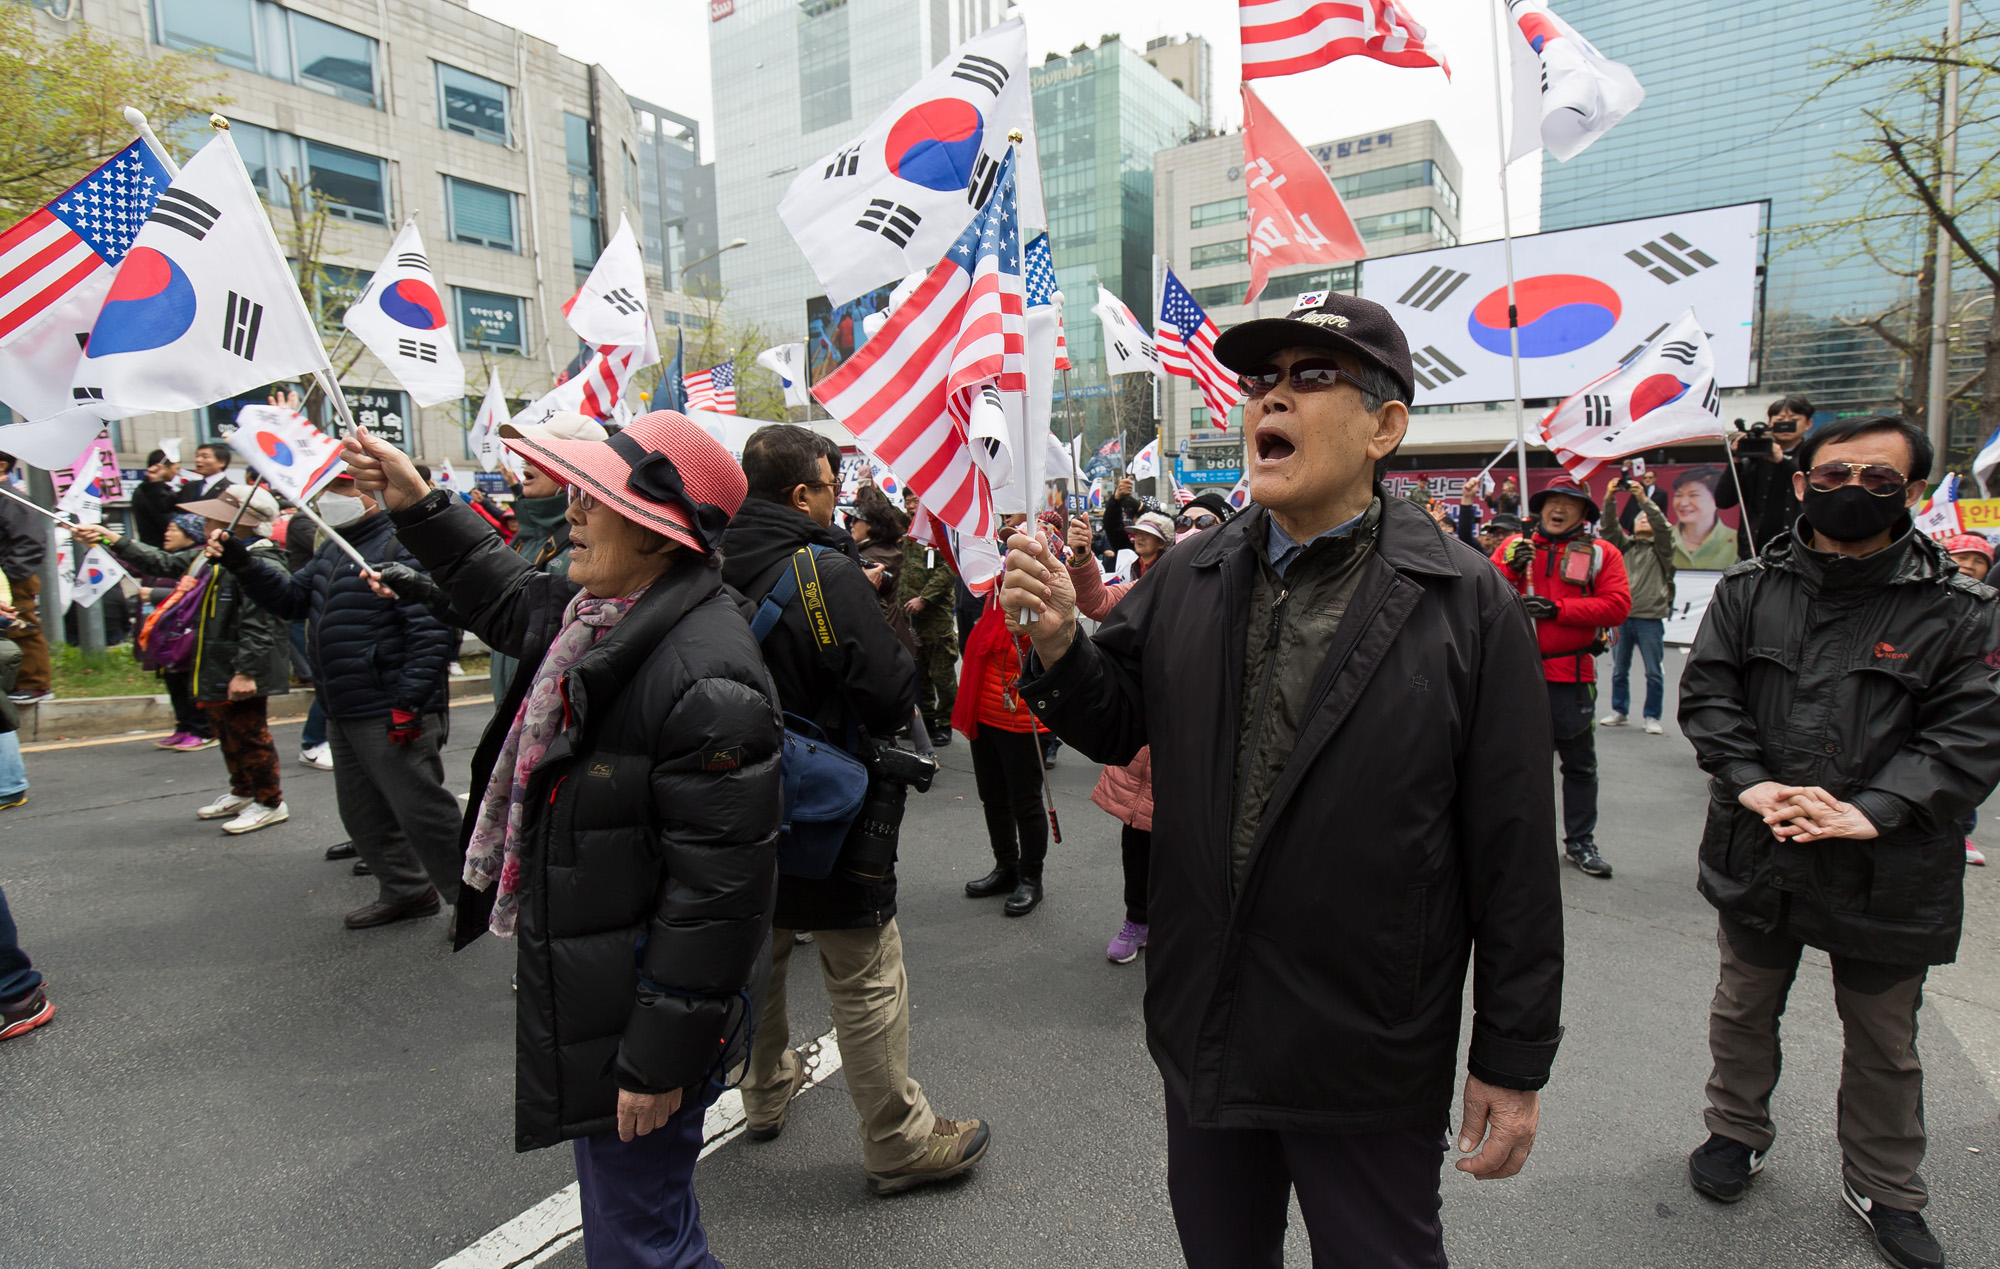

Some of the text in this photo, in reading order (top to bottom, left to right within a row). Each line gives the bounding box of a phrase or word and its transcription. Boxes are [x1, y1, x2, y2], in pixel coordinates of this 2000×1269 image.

[1311, 132, 1393, 162] 상담센터
[815, 611, 831, 644] Nikon
[1884, 652, 1909, 660] NEPA
